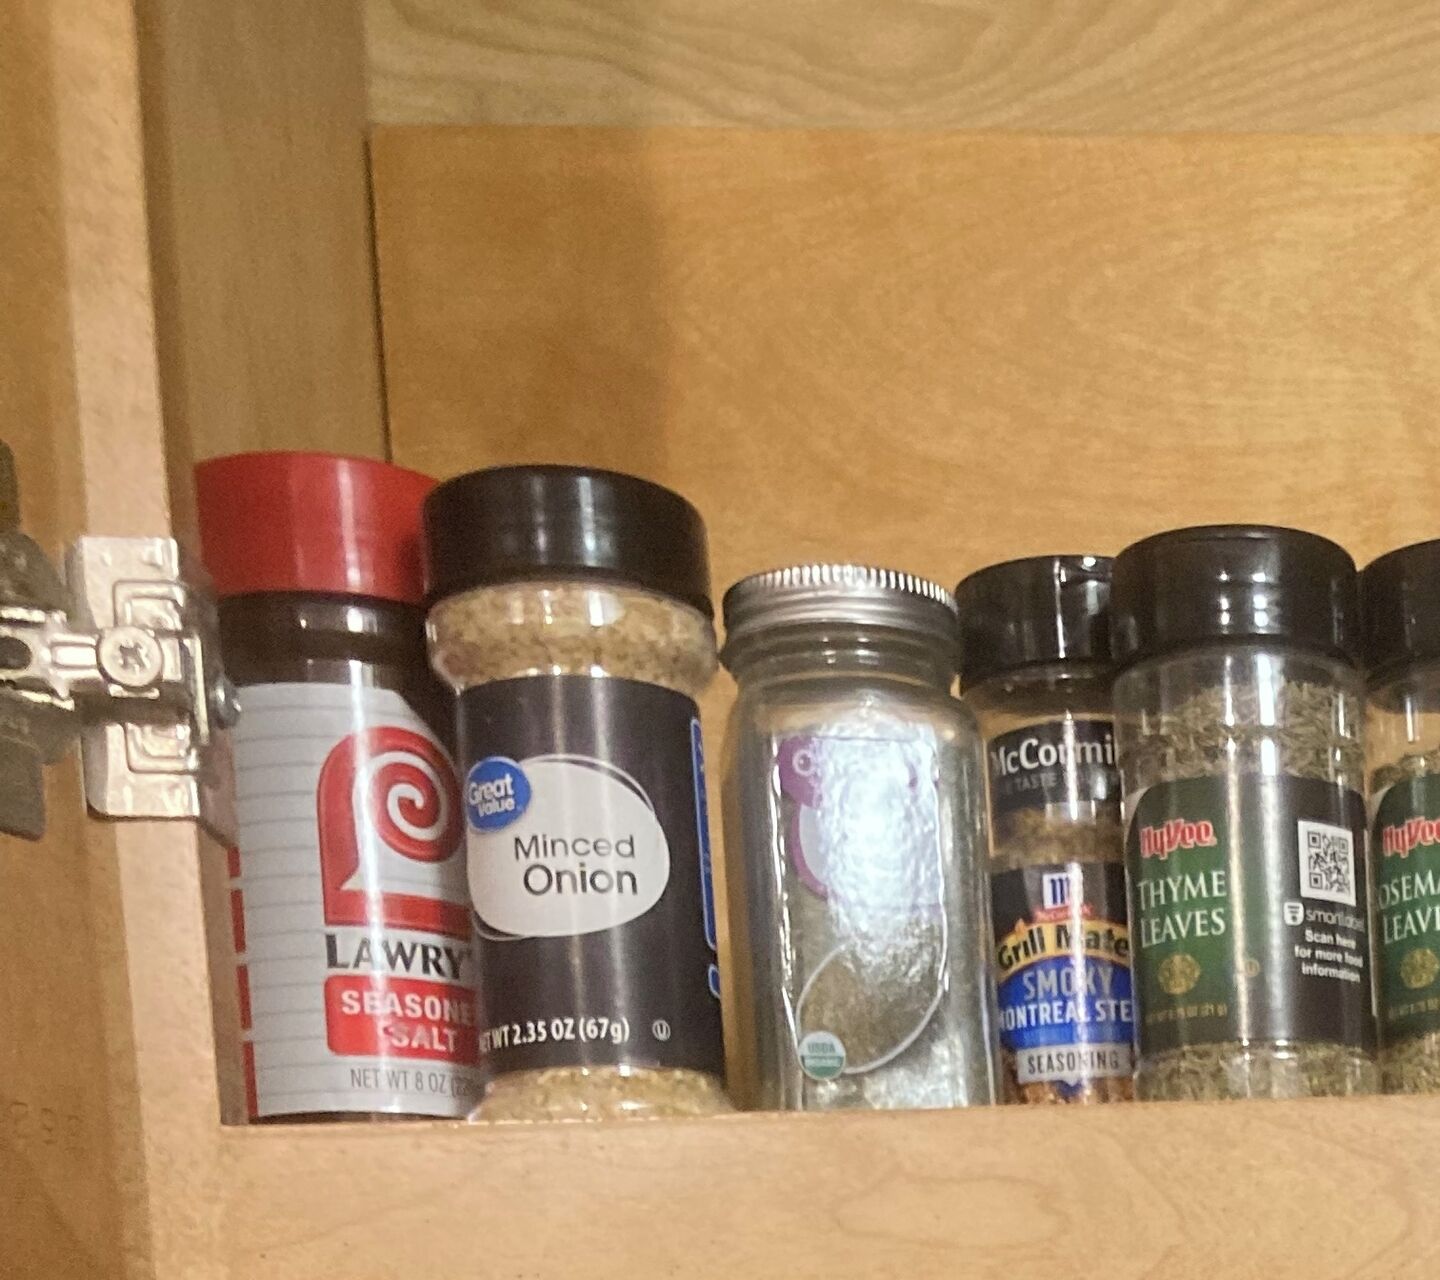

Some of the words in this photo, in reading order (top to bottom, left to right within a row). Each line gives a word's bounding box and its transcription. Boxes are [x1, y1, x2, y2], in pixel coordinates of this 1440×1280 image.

[468, 773, 514, 806] Great
[514, 834, 635, 862] Minced
[523, 862, 638, 896] Onion
[1137, 870, 1227, 911] THYME
[1140, 907, 1226, 949] LEAVES
[1305, 926, 1334, 945] Scan
[998, 926, 1046, 971] Grill
[1294, 943, 1312, 959] for
[1315, 949, 1343, 964] more
[1022, 961, 1113, 1002] SMOKY
[388, 1022, 459, 1052] SALT
[479, 1029, 491, 1053] ET
[492, 1024, 511, 1050] WT
[512, 1019, 548, 1044] 2.35
[551, 1017, 576, 1041] OZ
[578, 1016, 631, 1045] (67g)
[1028, 1049, 1119, 1075] SEASONING
[350, 1068, 380, 1090] NET
[386, 1069, 410, 1092] WT
[415, 1072, 424, 1092] 8
[428, 1072, 448, 1094] OZ
